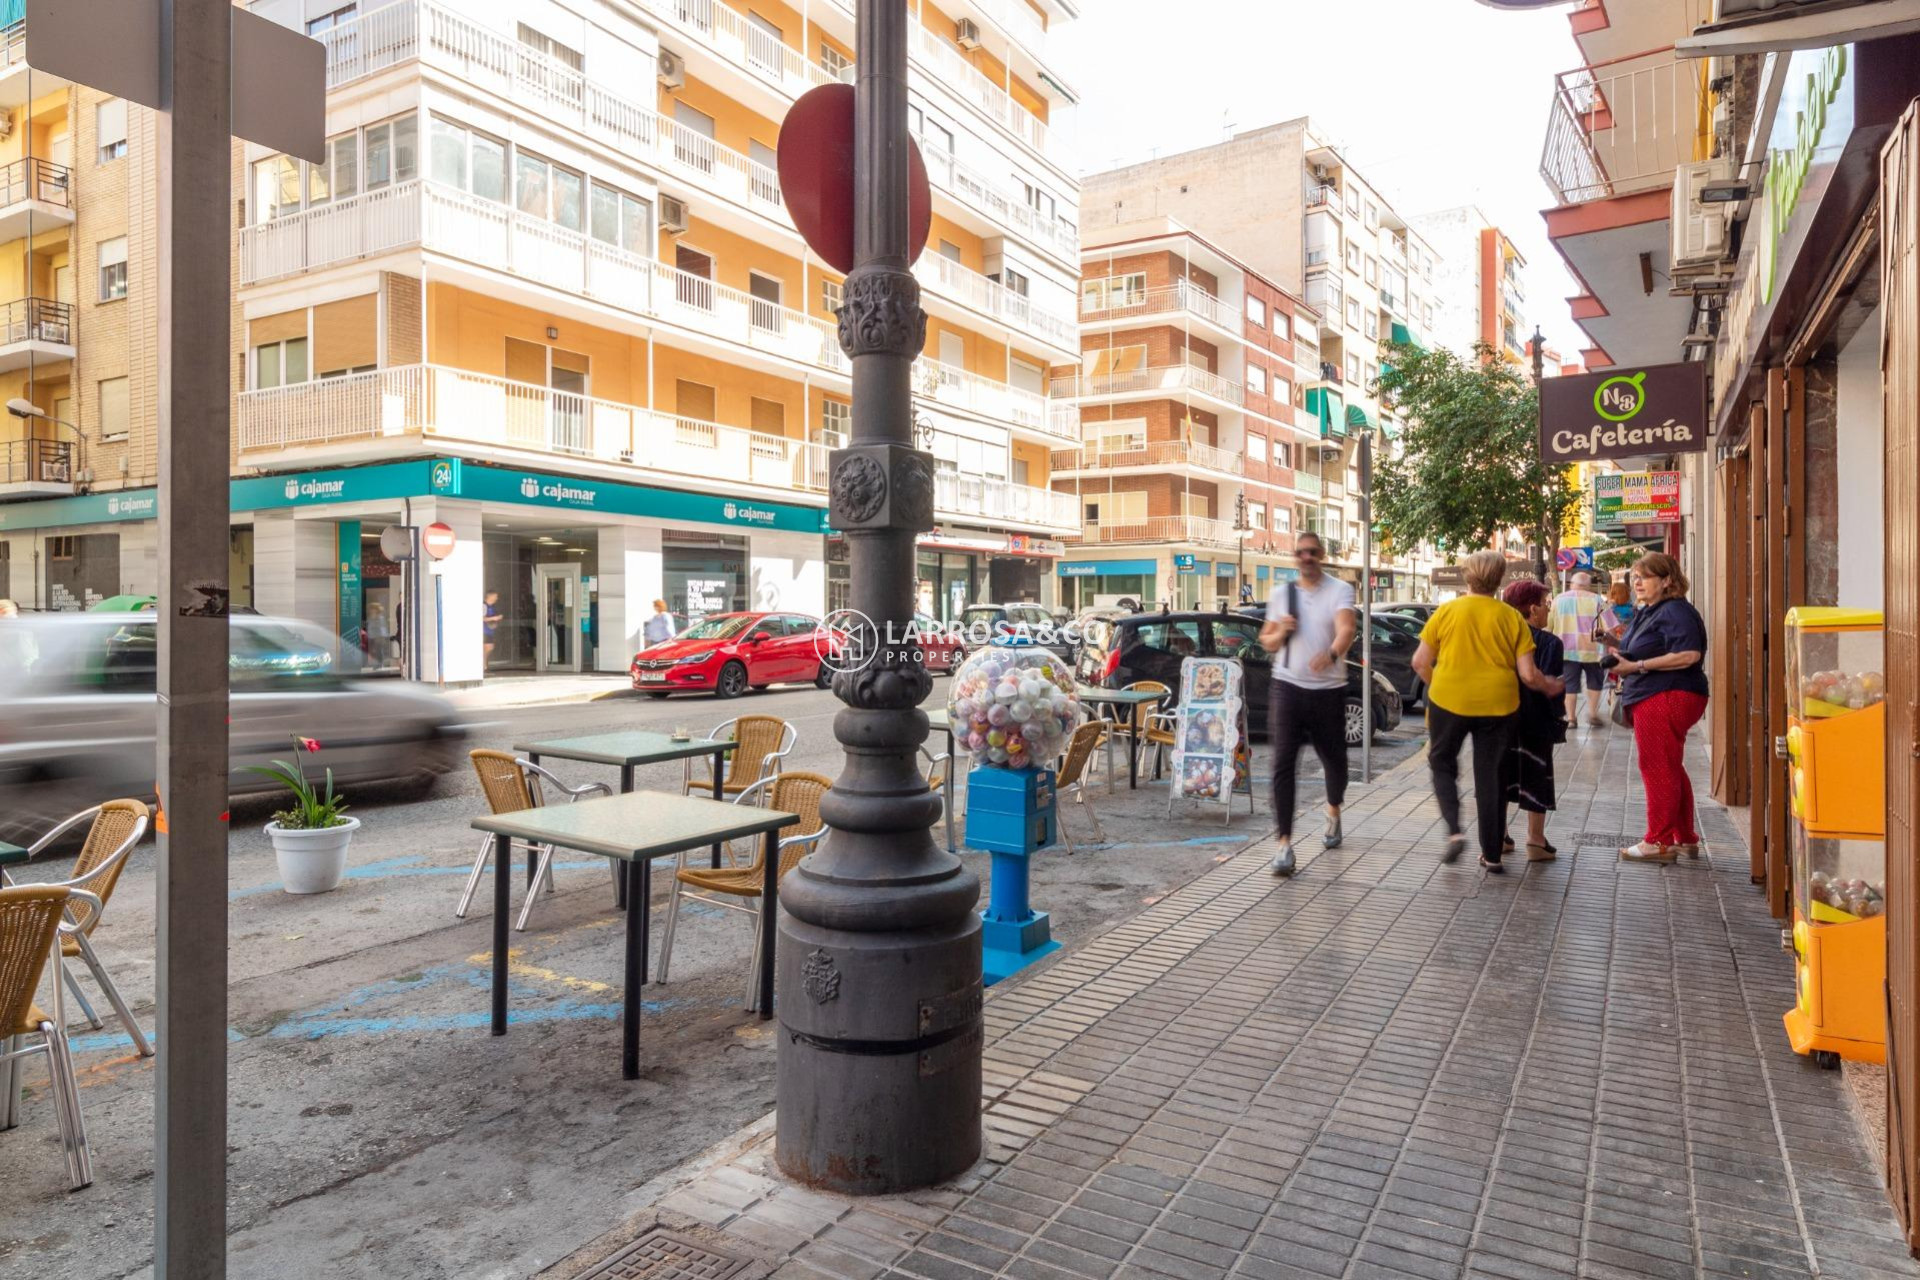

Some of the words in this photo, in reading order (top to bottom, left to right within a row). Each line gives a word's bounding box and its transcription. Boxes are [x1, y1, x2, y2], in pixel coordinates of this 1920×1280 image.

[1552, 418, 1693, 455] Cafetería
[301, 479, 344, 498] cajamar
[1597, 477, 1621, 490] SUPER
[1624, 476, 1648, 488] MAMA
[1650, 475, 1678, 487] AFRICA
[542, 482, 596, 502] cajamar
[120, 497, 154, 514] cajamar
[738, 506, 776, 522] cajamar
